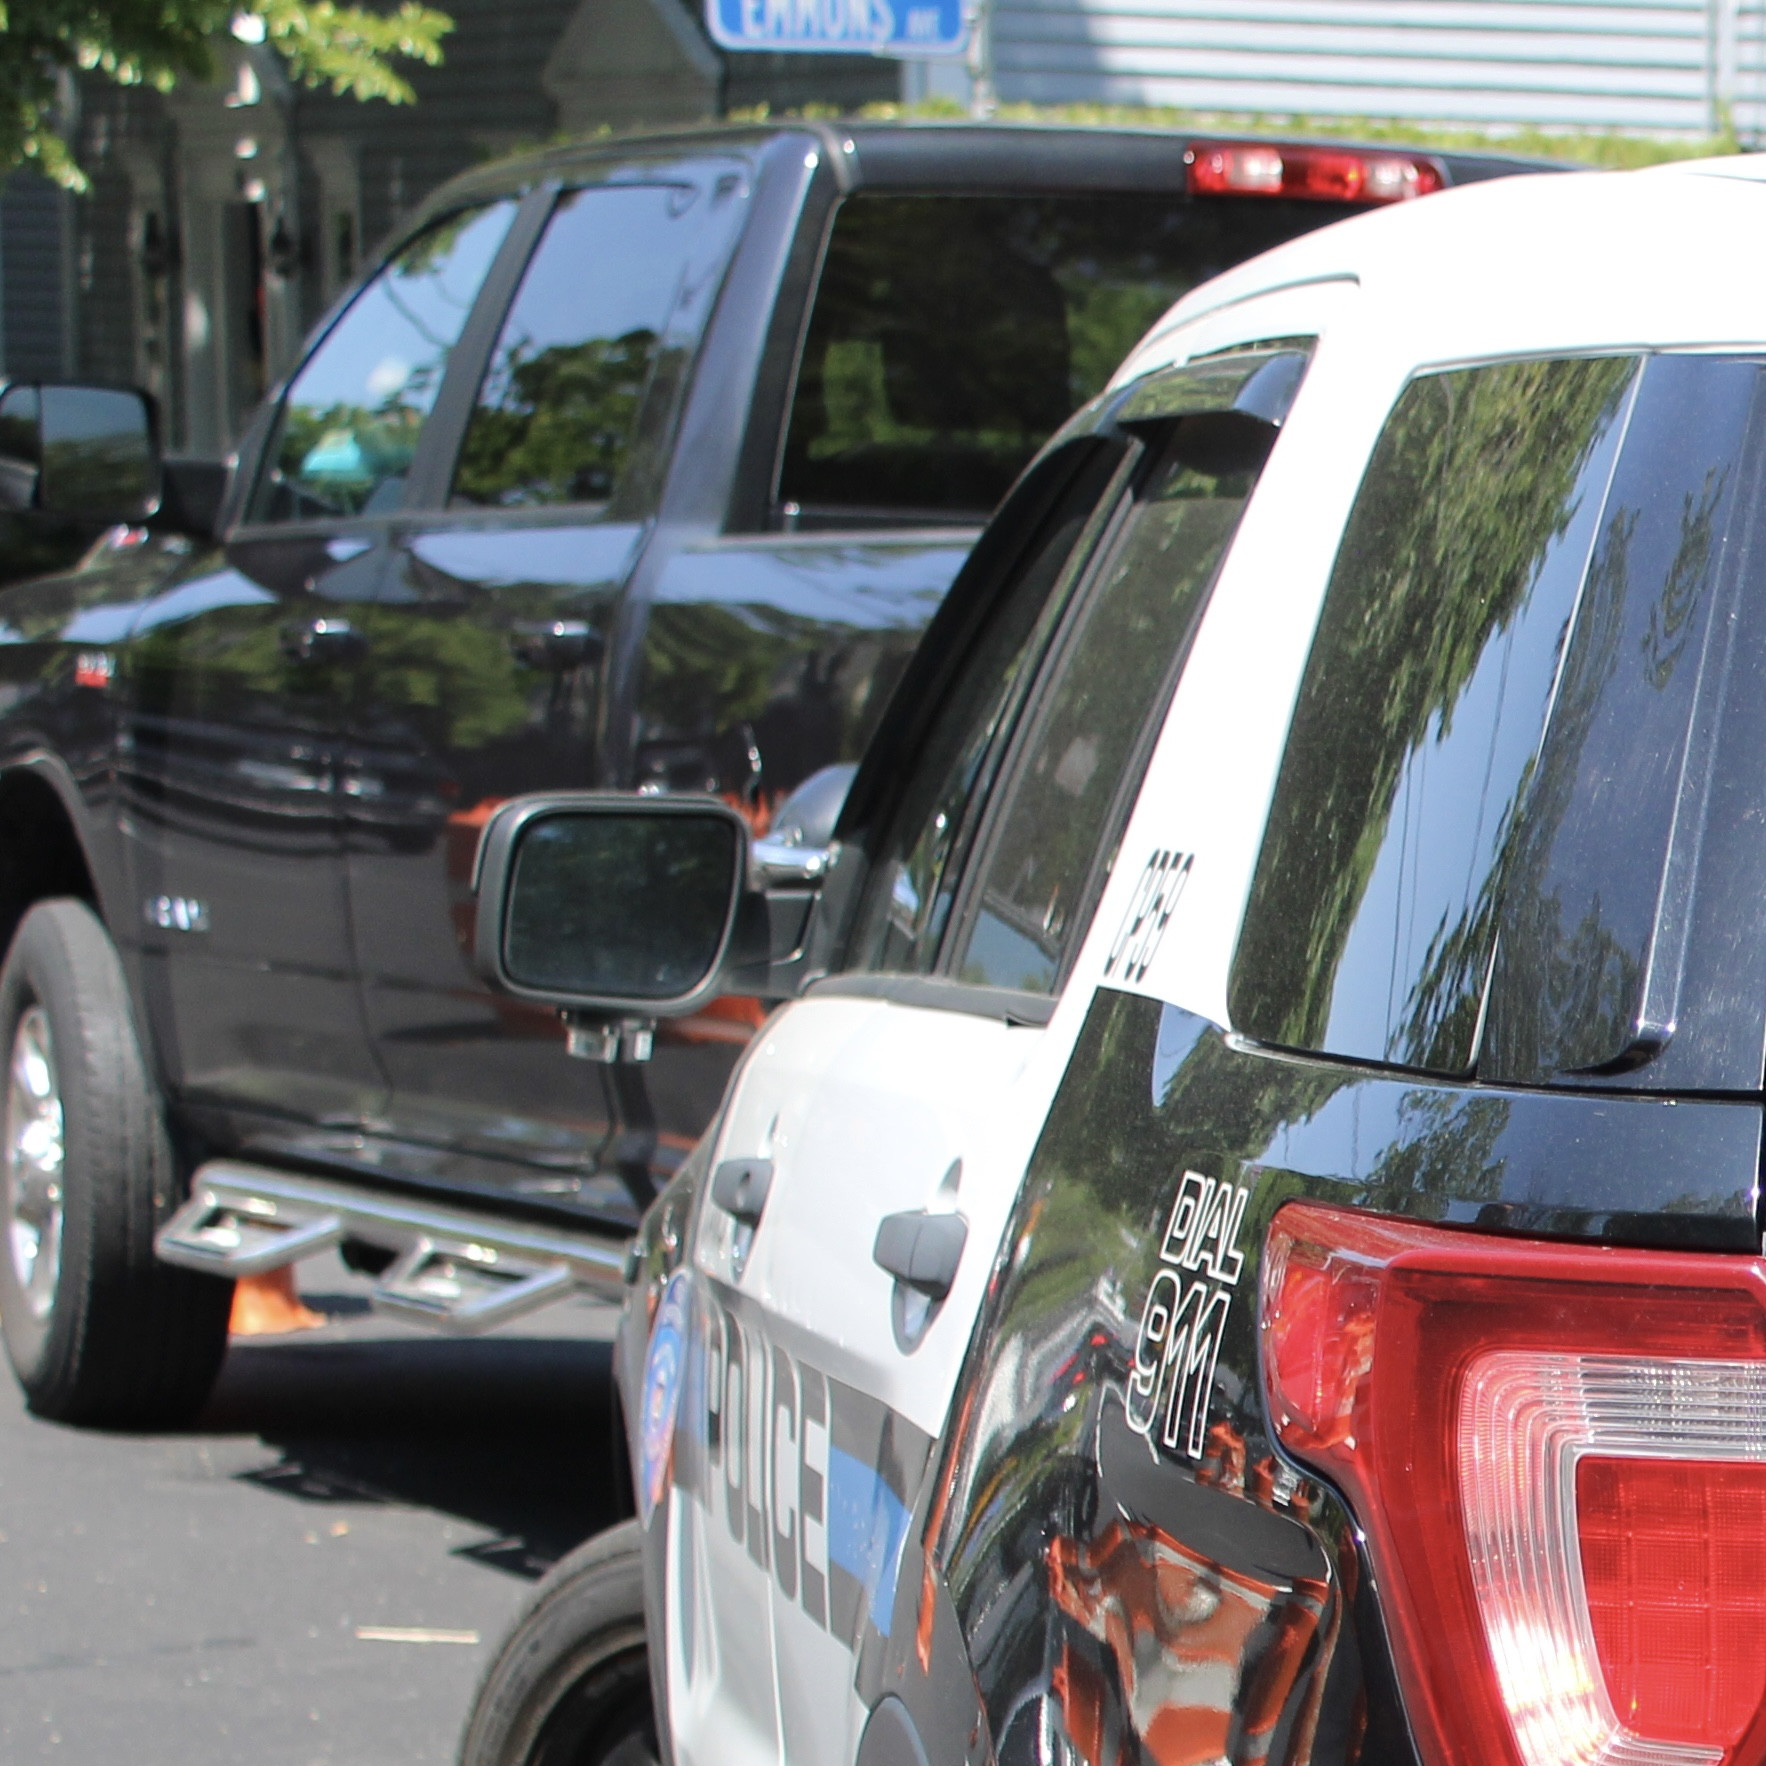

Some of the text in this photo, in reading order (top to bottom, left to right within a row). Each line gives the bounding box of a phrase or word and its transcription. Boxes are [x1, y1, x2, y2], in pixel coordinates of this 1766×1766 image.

[1160, 1170, 1249, 1285] DIAL
[1126, 1269, 1231, 1460] 911
[702, 1298, 830, 1634] POLICE
